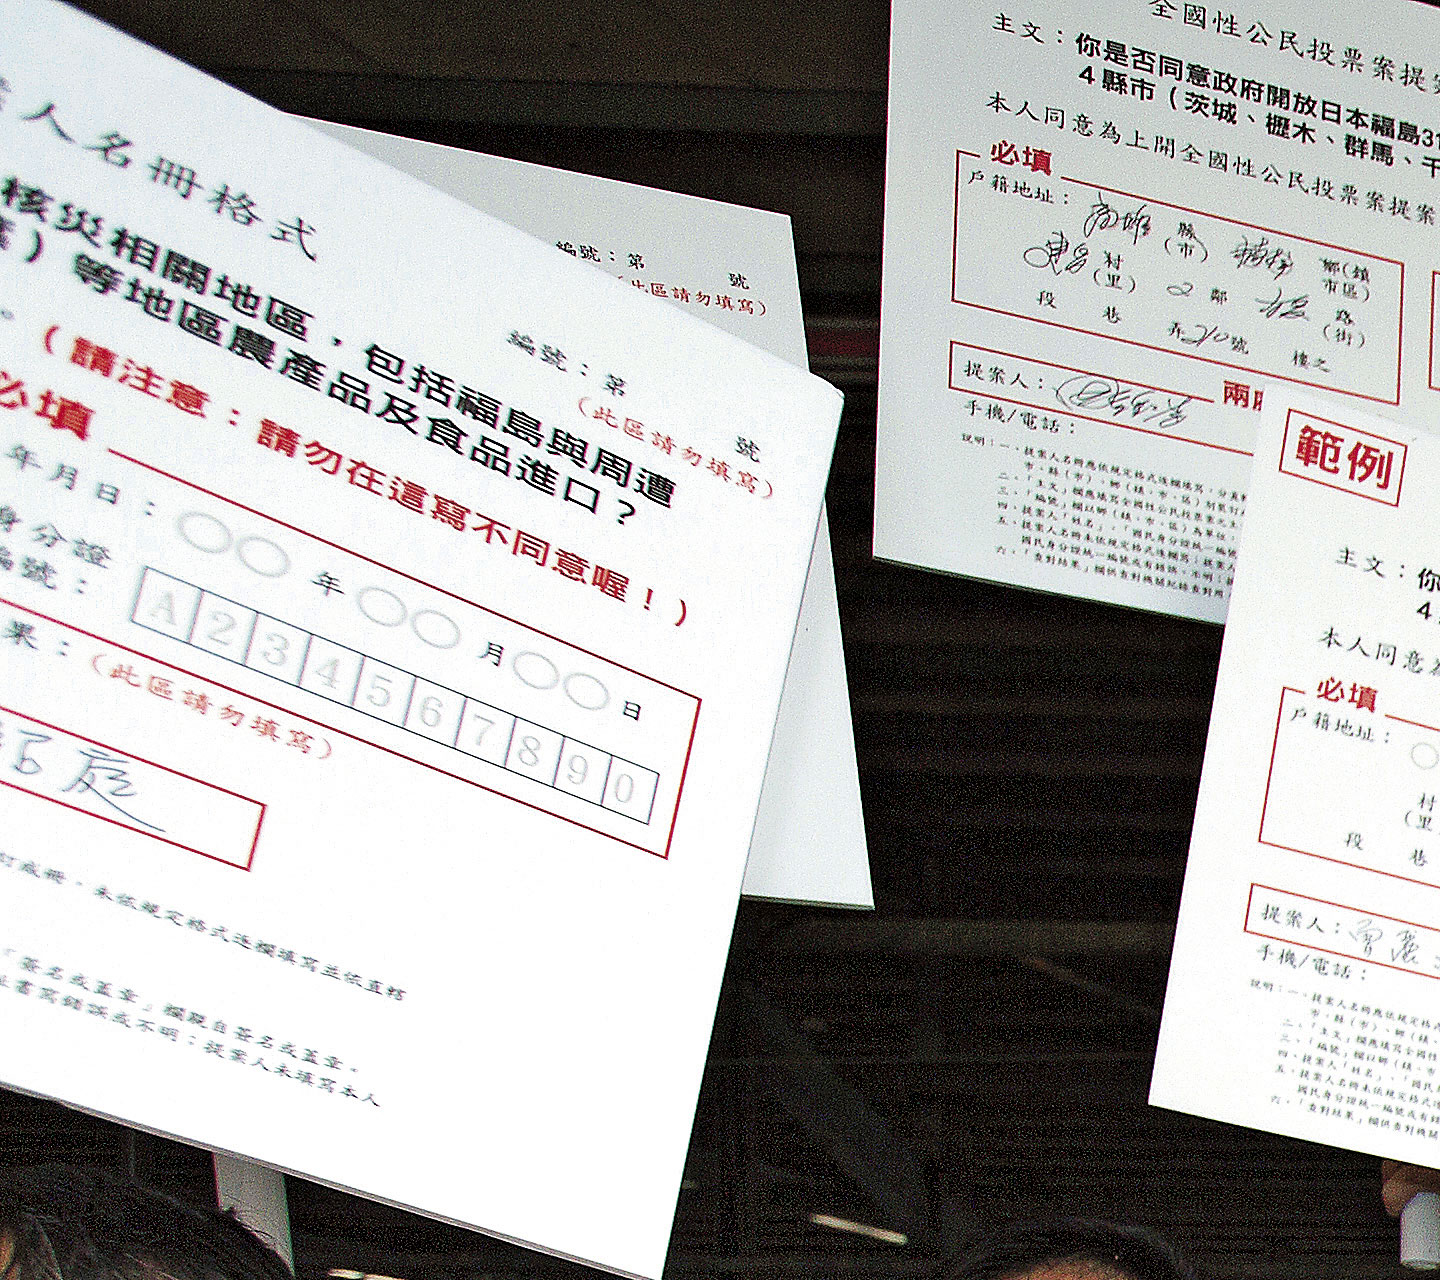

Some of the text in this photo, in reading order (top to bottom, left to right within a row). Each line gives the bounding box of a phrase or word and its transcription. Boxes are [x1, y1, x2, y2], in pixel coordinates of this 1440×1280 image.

[2, 76, 326, 263] 人名冊格式
